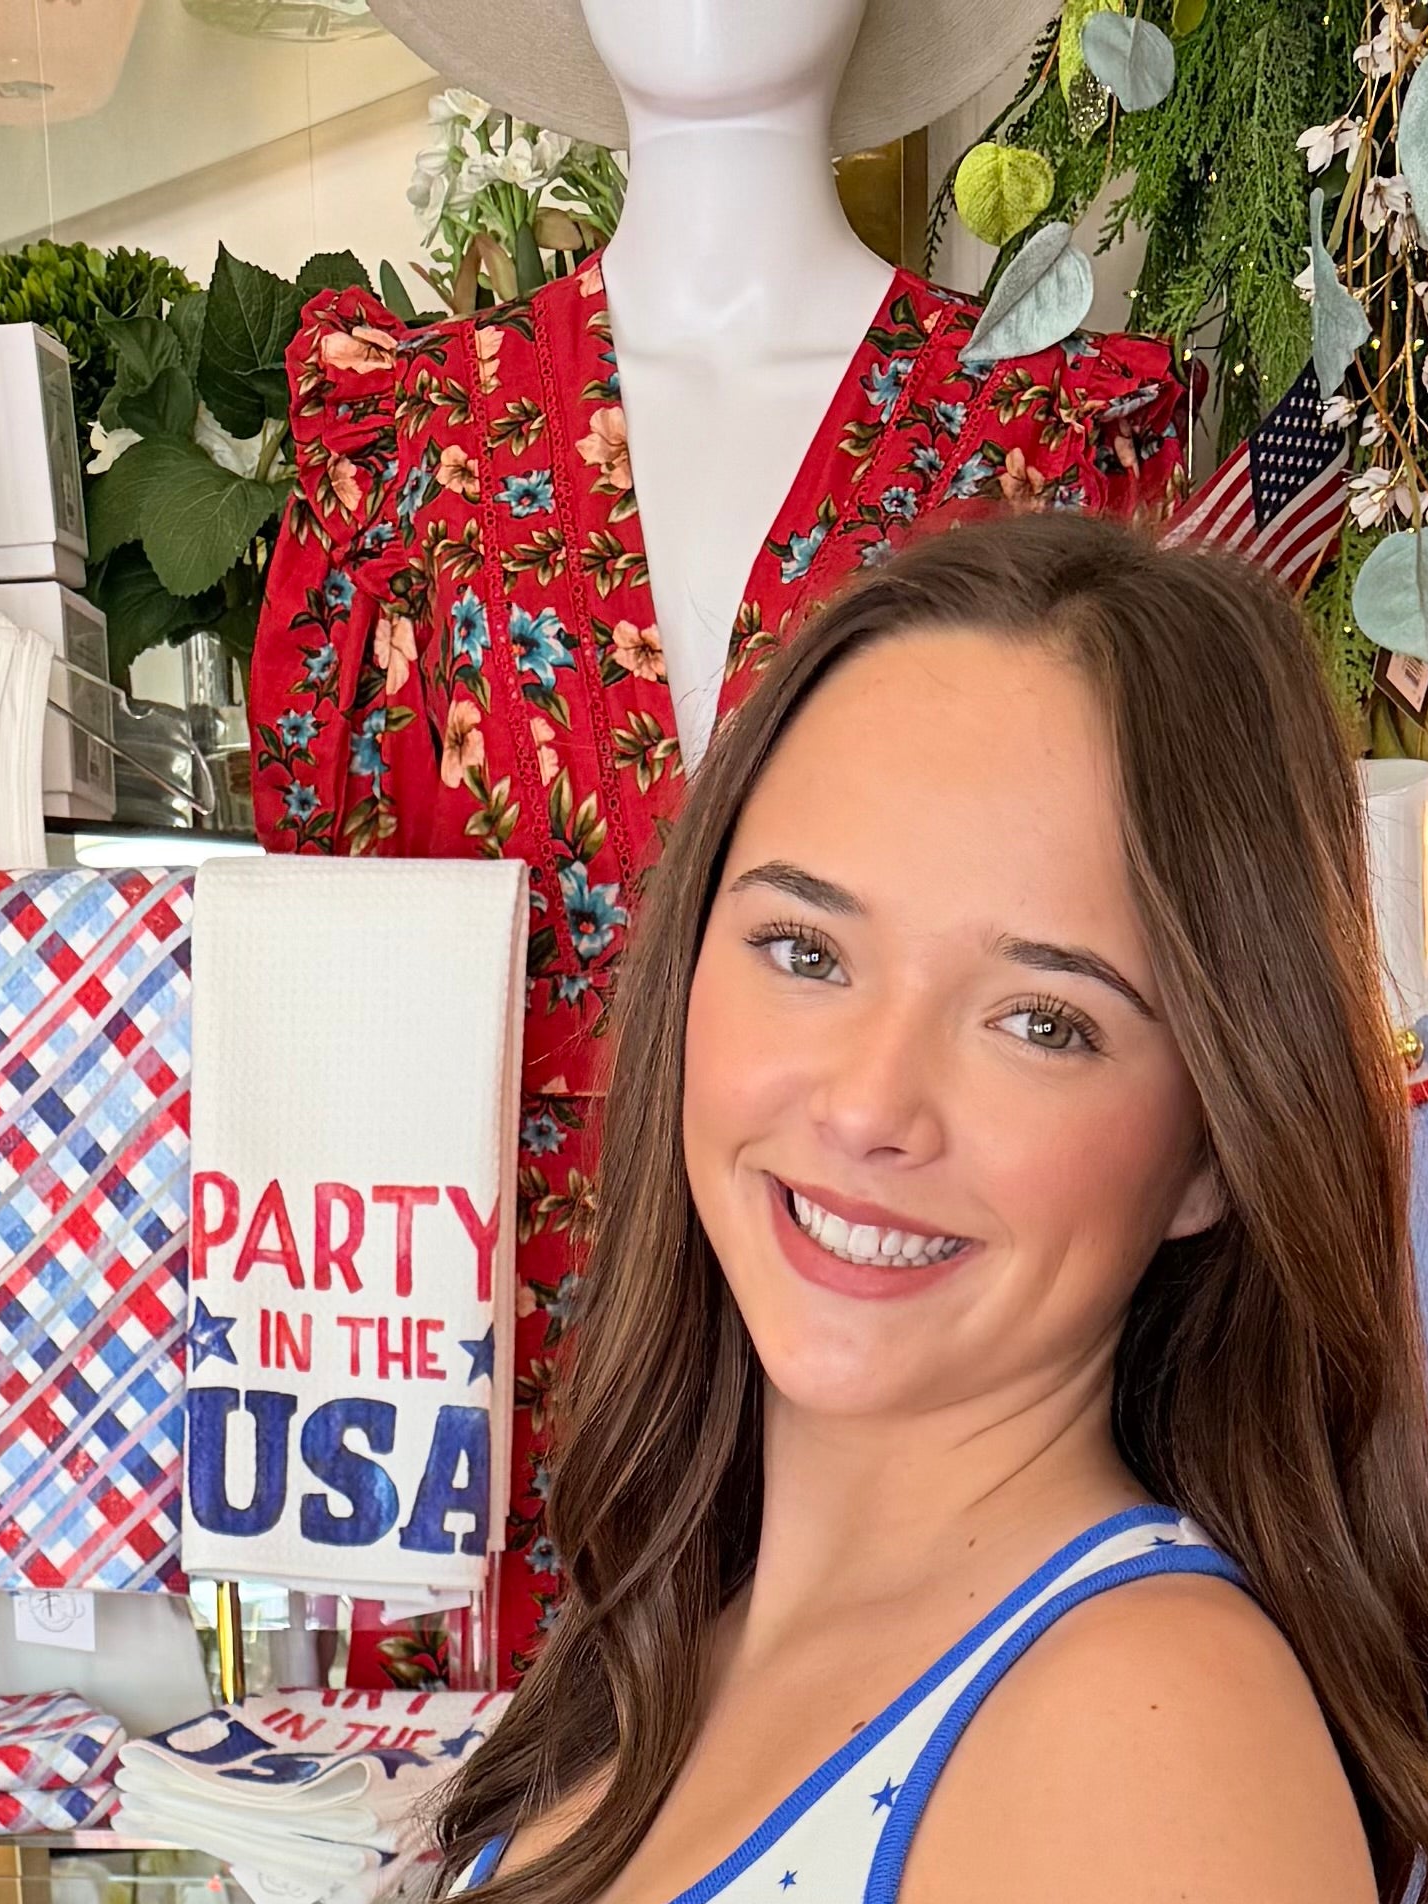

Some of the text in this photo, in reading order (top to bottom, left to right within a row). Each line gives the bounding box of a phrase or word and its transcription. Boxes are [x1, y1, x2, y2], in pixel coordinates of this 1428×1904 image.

[192, 1171, 500, 1302] PARTY
[260, 1309, 447, 1380] IN THE
[187, 1386, 491, 1556] USA
[262, 1708, 326, 1741] IN
